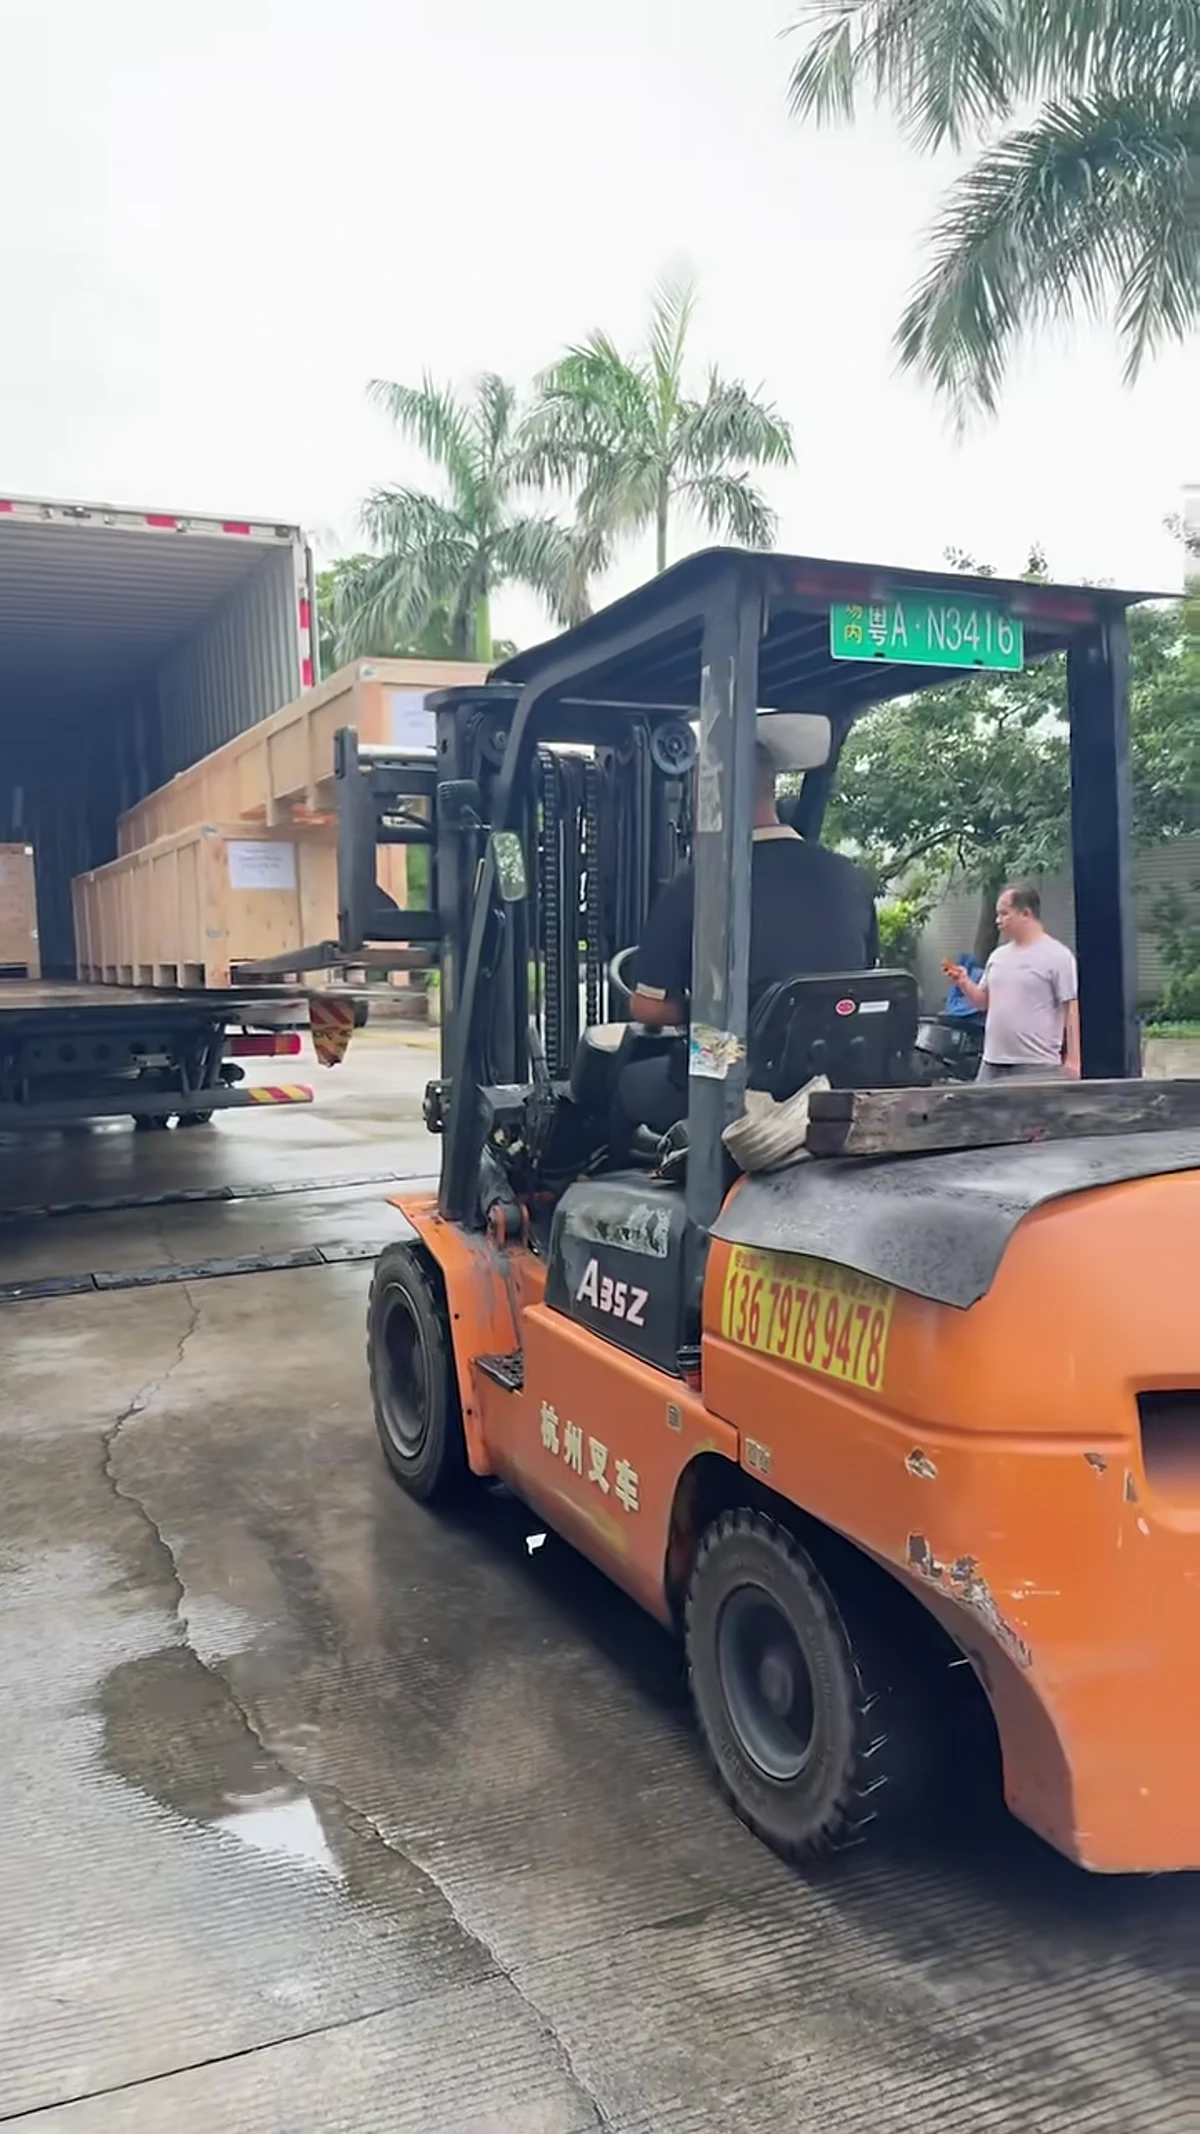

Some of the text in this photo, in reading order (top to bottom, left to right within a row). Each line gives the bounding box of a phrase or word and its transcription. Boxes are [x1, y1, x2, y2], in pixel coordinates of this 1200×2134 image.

[576, 1259, 648, 1326] A35Z
[540, 1401, 640, 1512] 杭州叉车
